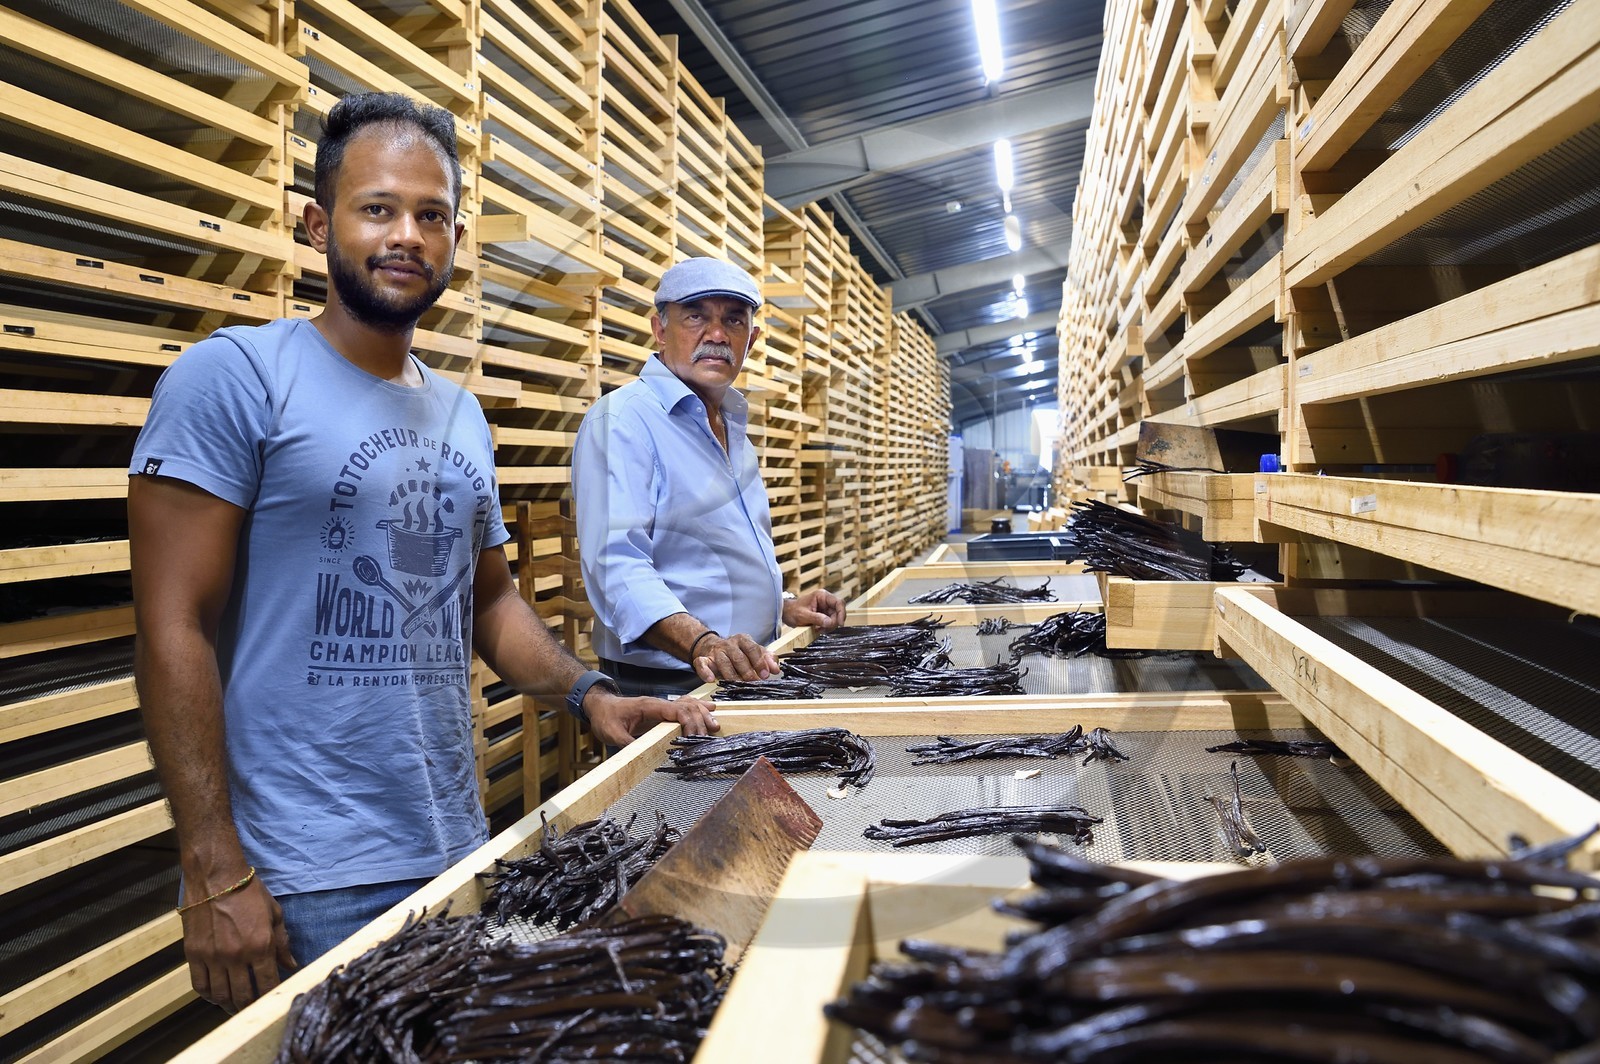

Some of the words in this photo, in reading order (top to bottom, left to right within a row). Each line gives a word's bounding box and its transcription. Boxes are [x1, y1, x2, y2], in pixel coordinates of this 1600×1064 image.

[330, 428, 419, 511] TOTOCHEUR
[423, 437, 436, 450] DE
[441, 442, 489, 527] ROUGAIL
[319, 557, 341, 565] SINCE
[315, 573, 394, 639] WORLD
[310, 641, 417, 663] CHAMPION
[328, 675, 344, 687] LA
[353, 675, 407, 687] RENYON
